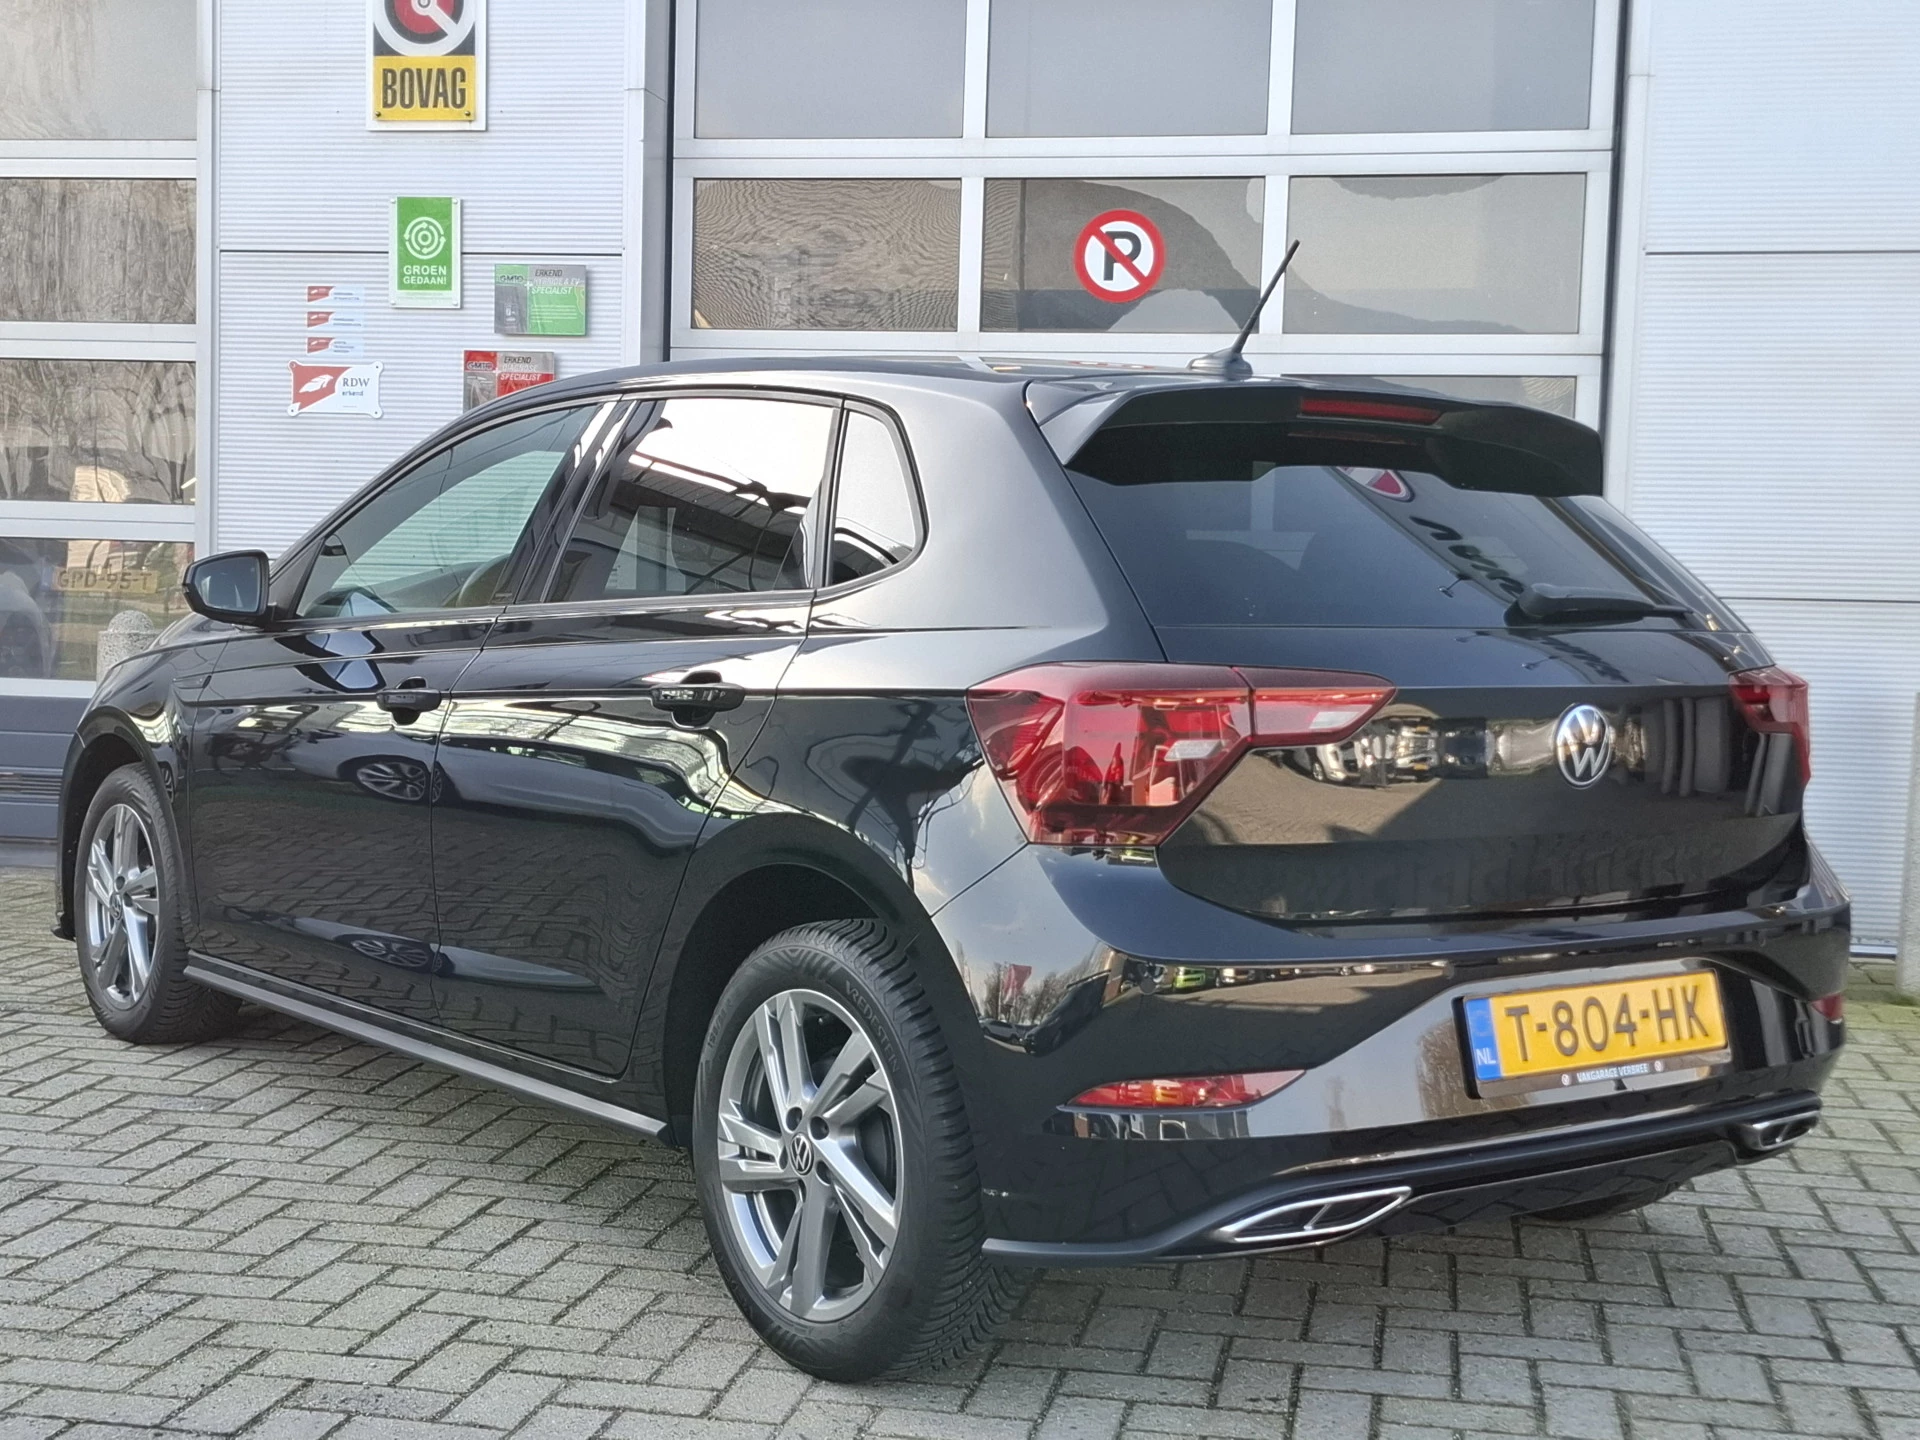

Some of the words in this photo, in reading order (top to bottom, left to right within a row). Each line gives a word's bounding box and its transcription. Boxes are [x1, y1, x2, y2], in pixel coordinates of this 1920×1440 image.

[382, 67, 467, 109] BOVAG
[403, 265, 447, 276] GROEN
[534, 269, 563, 277] ERKEND
[403, 276, 447, 285] GEDAAN!
[531, 286, 573, 295] SPECIALIST
[503, 356, 532, 364] ERKEND
[500, 373, 541, 381] SPECIALIST
[342, 378, 370, 387] RDW
[1504, 984, 1709, 1062] T-804-HK
[1476, 1048, 1496, 1066] NL
